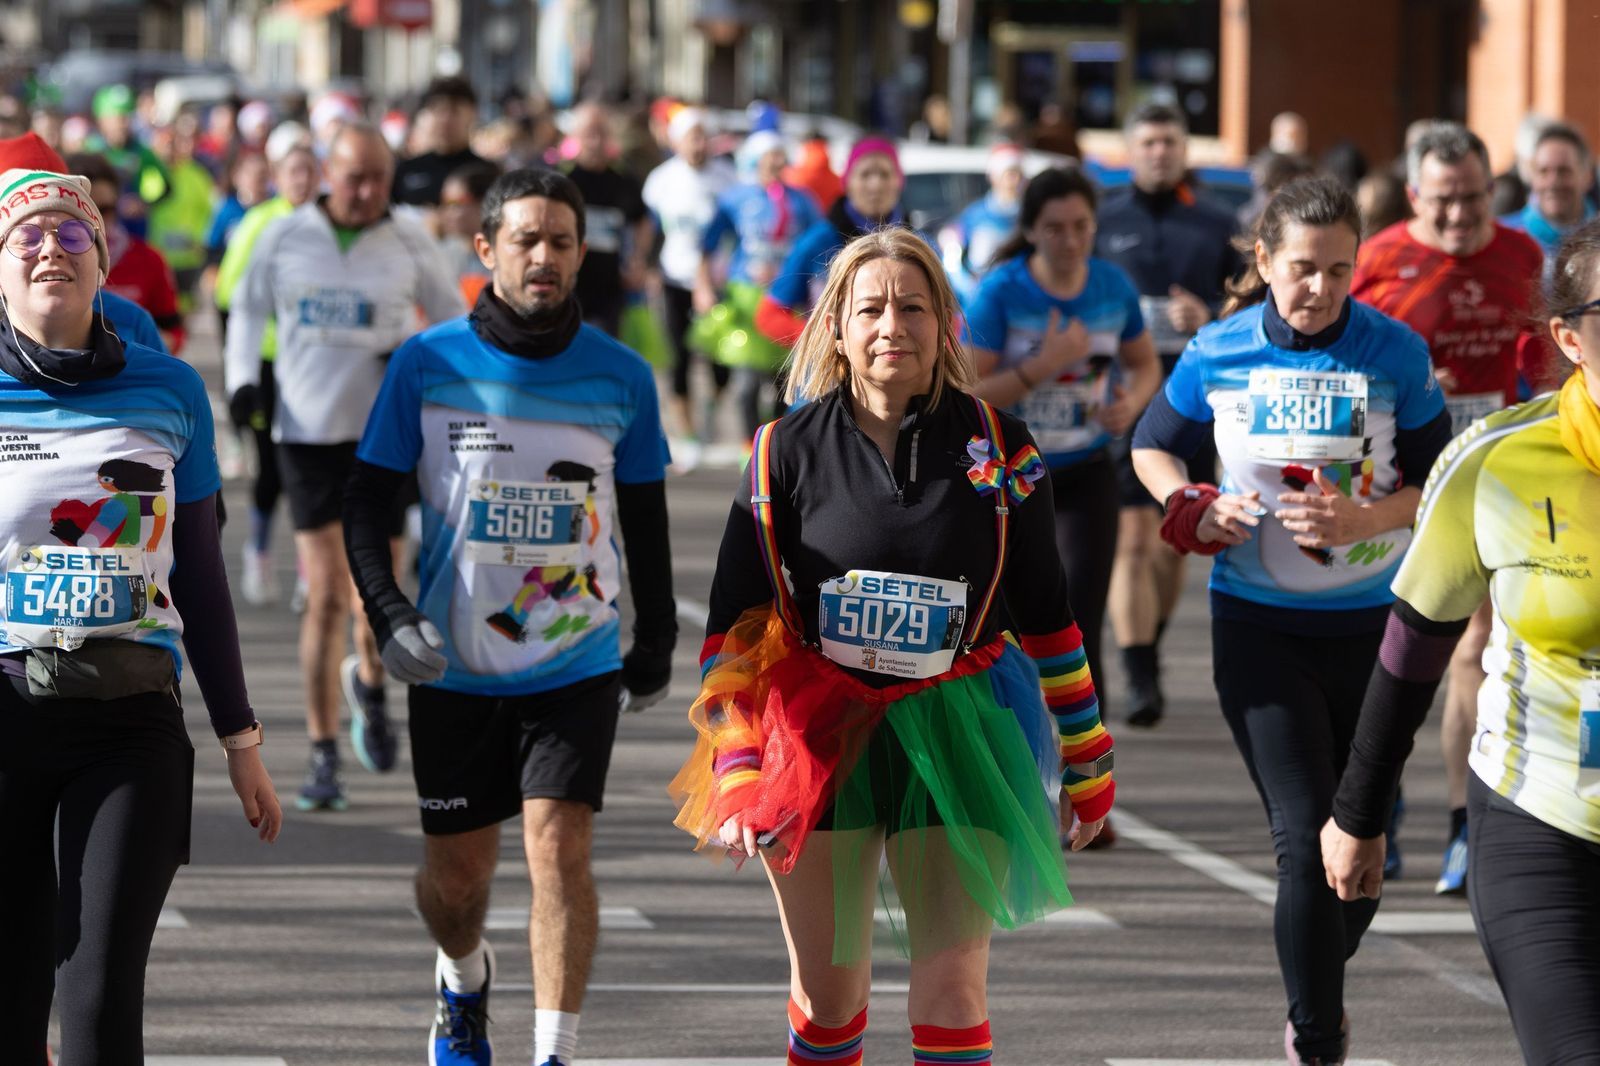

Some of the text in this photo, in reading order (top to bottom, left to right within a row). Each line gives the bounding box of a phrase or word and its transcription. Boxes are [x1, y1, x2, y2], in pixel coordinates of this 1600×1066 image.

[1280, 378, 1354, 393] SETEL
[1266, 394, 1332, 430] 3381
[0, 452, 60, 462] LMANTINA
[501, 486, 575, 500] SETEL
[486, 503, 553, 539] 5616
[46, 553, 129, 571] SETEL
[23, 575, 115, 618] 5488
[861, 576, 951, 602] SETEL
[838, 596, 929, 645] 5029
[864, 639, 899, 651] SUSANA
[878, 657, 917, 667] Ayuntamiento
[886, 665, 916, 675] Salamanca
